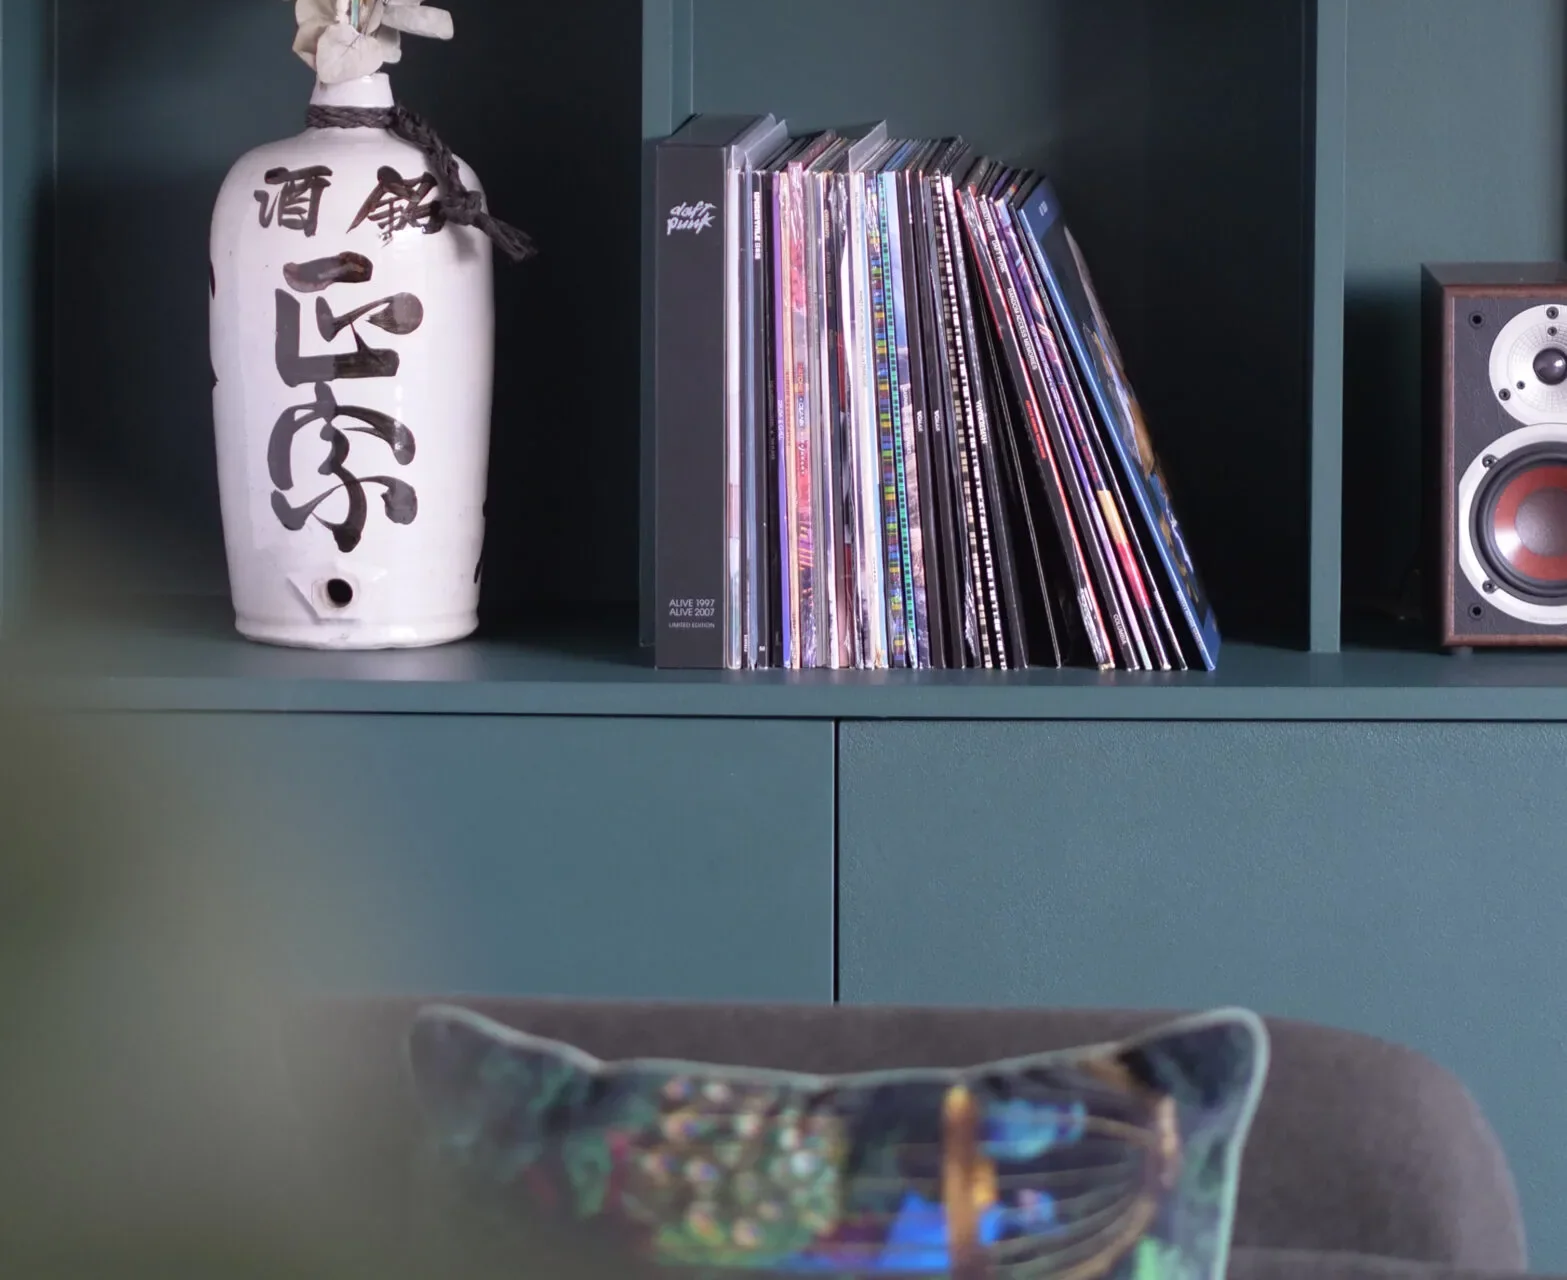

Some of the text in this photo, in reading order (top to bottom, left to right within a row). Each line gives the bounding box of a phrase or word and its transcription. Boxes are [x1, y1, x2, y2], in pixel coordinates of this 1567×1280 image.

[670, 200, 718, 219] daft
[666, 212, 717, 236] punk
[1007, 287, 1019, 314] RANDOM
[1016, 313, 1028, 337] ACCESS
[1024, 338, 1038, 370] MEMORIES
[669, 598, 715, 608] ALIVE 1997
[669, 607, 715, 617] ALIVE 2007
[1113, 613, 1127, 645] COLUMBIA
